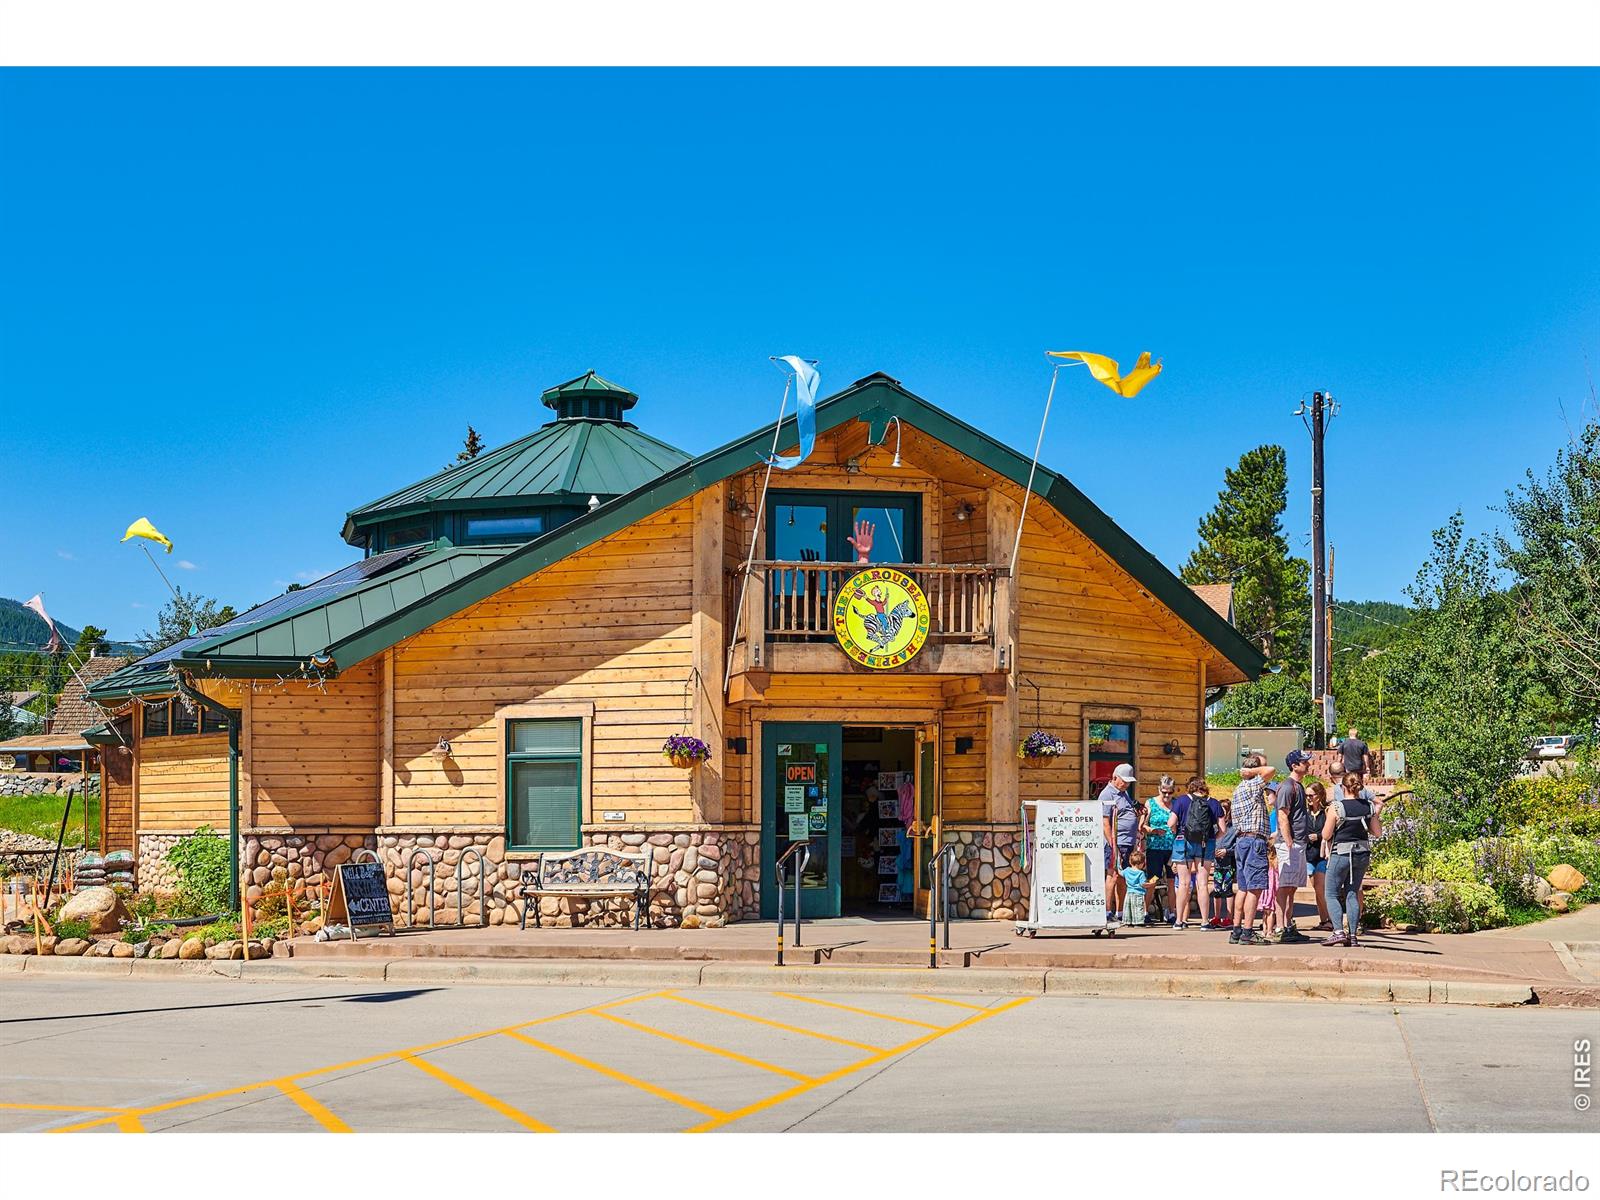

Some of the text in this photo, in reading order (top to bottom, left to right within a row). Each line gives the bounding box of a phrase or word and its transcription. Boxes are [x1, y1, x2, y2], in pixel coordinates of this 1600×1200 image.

[836, 570, 928, 667] THE CAROUSEL OF HAPPINESS
[787, 766, 814, 781] OPEN
[1071, 829, 1092, 837] RIDES!
[360, 897, 390, 913] CENTER
[1065, 898, 1105, 906] HAPPINESS
